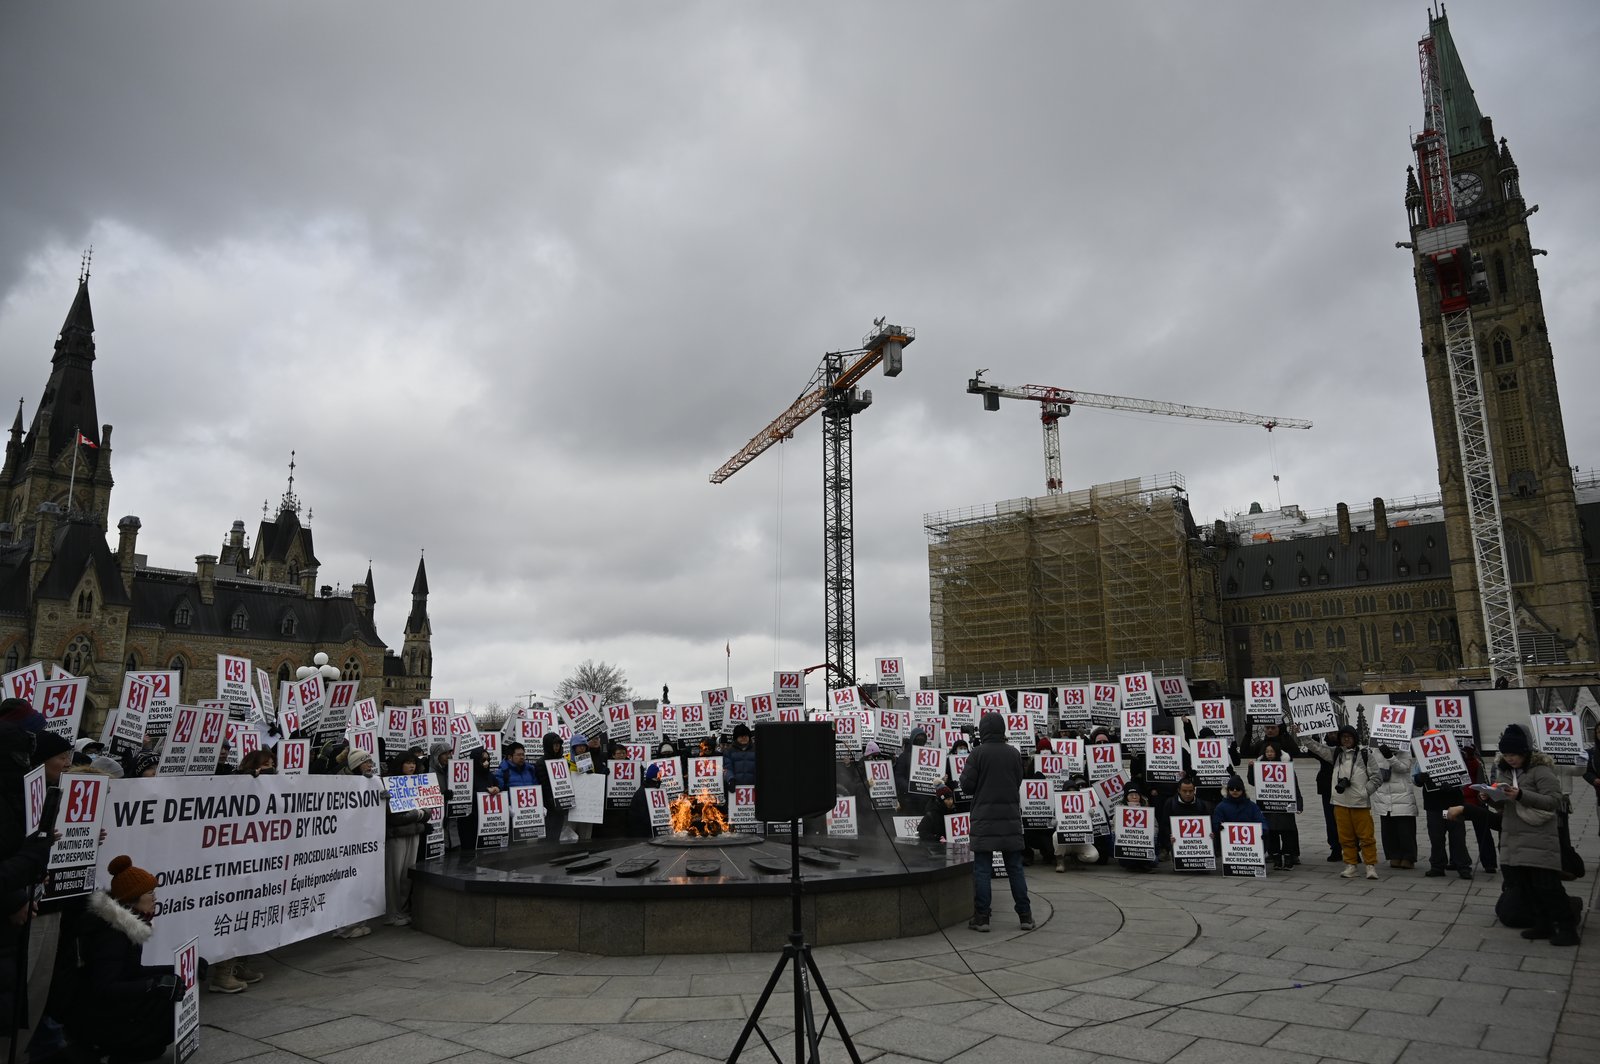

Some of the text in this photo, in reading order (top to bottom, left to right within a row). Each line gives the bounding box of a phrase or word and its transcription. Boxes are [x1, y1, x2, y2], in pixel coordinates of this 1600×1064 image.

[226, 660, 245, 682] 43
[882, 660, 897, 673] 43
[782, 674, 798, 688] 22
[1128, 676, 1146, 692] 43
[1163, 680, 1180, 694] 40
[1254, 681, 1272, 697] 33
[129, 683, 146, 712] 31
[302, 679, 319, 704] 39
[333, 686, 350, 707] 11
[710, 691, 726, 706] 28
[836, 690, 853, 704] 23
[917, 692, 932, 706] 36
[1066, 690, 1082, 704] 63
[1096, 686, 1114, 702] 42
[1287, 684, 1328, 700] CANADA
[45, 684, 73, 718] 54
[431, 702, 446, 714] 19
[754, 696, 770, 713] 13
[955, 699, 970, 712] 72
[986, 694, 1000, 706] 27
[1025, 694, 1041, 709] 30
[1438, 700, 1459, 716] 13
[361, 702, 374, 720] 34
[566, 700, 586, 719] 30
[612, 706, 628, 721] 27
[684, 706, 701, 721] 39
[732, 704, 748, 720] 38
[1205, 703, 1223, 719] 37
[1290, 702, 1331, 718] WHAT ARE
[1383, 708, 1406, 723] 37
[174, 711, 194, 742] 24
[390, 711, 406, 730] 39
[433, 718, 446, 735] 36
[451, 717, 470, 734] 30
[638, 716, 654, 731] 32
[837, 718, 853, 734] 68
[882, 712, 898, 729] 53
[1010, 715, 1026, 730] 23
[1129, 712, 1145, 726] 55
[1294, 714, 1336, 733] YOU DOING?
[1548, 718, 1570, 734] 22
[203, 713, 222, 743] 34
[524, 721, 540, 738] 30
[627, 746, 643, 760] 32
[1156, 738, 1174, 754] 33
[1200, 742, 1219, 758] 40
[1424, 736, 1446, 757] 29
[286, 744, 302, 768] 19
[920, 750, 938, 766] 30
[1096, 746, 1114, 763] 27
[1429, 756, 1450, 764] MONTHS
[455, 762, 468, 782] 36
[552, 762, 567, 779] 20
[616, 762, 633, 779] 34
[697, 760, 715, 776] 34
[873, 763, 888, 780] 30
[1044, 757, 1060, 772] 40
[1426, 762, 1446, 770] WAITING
[1436, 766, 1462, 774] RESPONSE
[388, 774, 428, 788] STOP THE
[1264, 764, 1284, 782] 26
[1028, 782, 1046, 799] 20
[1105, 776, 1122, 797] 18
[70, 781, 95, 822] 31
[519, 790, 536, 808] 35
[652, 791, 665, 808] 51
[738, 788, 754, 805] 31
[1064, 795, 1082, 812] 40
[114, 790, 380, 827] WE DEMAND A TIMELY DECISION
[486, 796, 500, 814] 11
[833, 800, 848, 818] 42
[952, 816, 969, 836] 34
[1126, 809, 1146, 828] 32
[66, 828, 90, 838] MONTHS
[202, 815, 337, 848] DELAYED BY IRCC
[1182, 820, 1202, 838] 22
[1232, 826, 1252, 844] 19
[58, 839, 94, 850] WAITING FOR
[64, 850, 95, 862] RESPONSE
[55, 870, 86, 880] NO TIMELINES
[155, 865, 212, 887] ONABLE
[214, 856, 283, 878] TIMELINES
[294, 847, 338, 866] PROCEDURAL
[54, 880, 84, 891] NO RESULTS
[154, 866, 357, 917] Délais raisonnables Équité procédurale
[214, 893, 326, 936] 给出时限 程序公平
